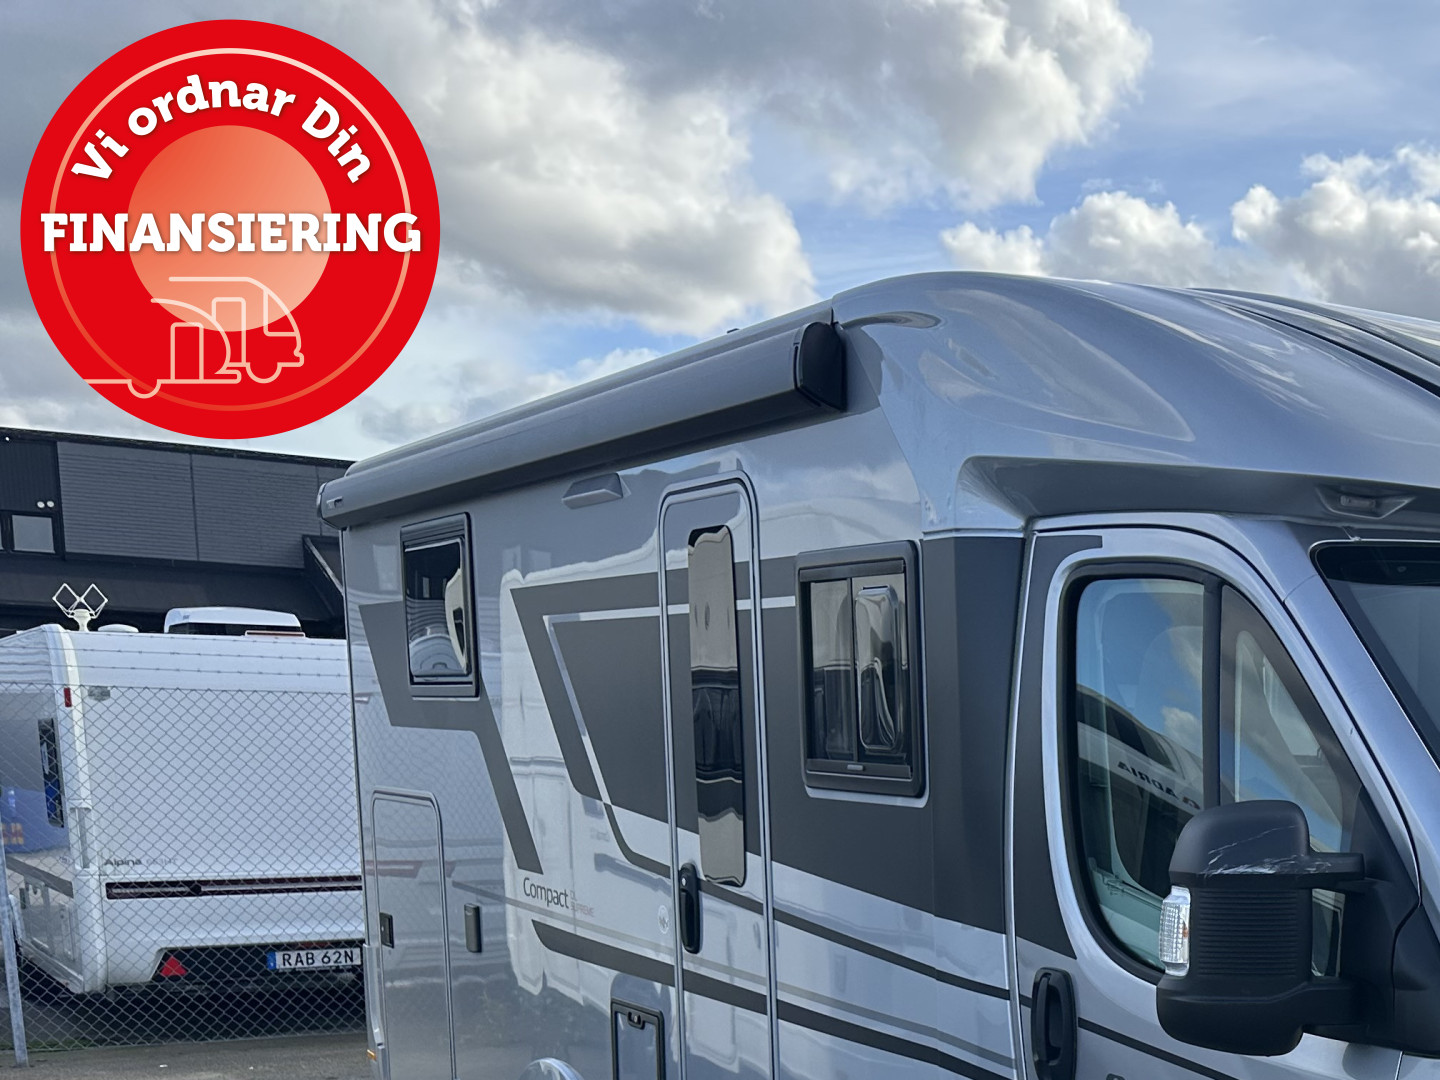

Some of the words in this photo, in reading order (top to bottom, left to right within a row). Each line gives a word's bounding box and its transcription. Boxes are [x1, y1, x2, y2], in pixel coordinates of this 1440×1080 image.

[523, 877, 569, 909] Compact
[282, 952, 315, 966] RAB
[322, 950, 354, 964] 62N
